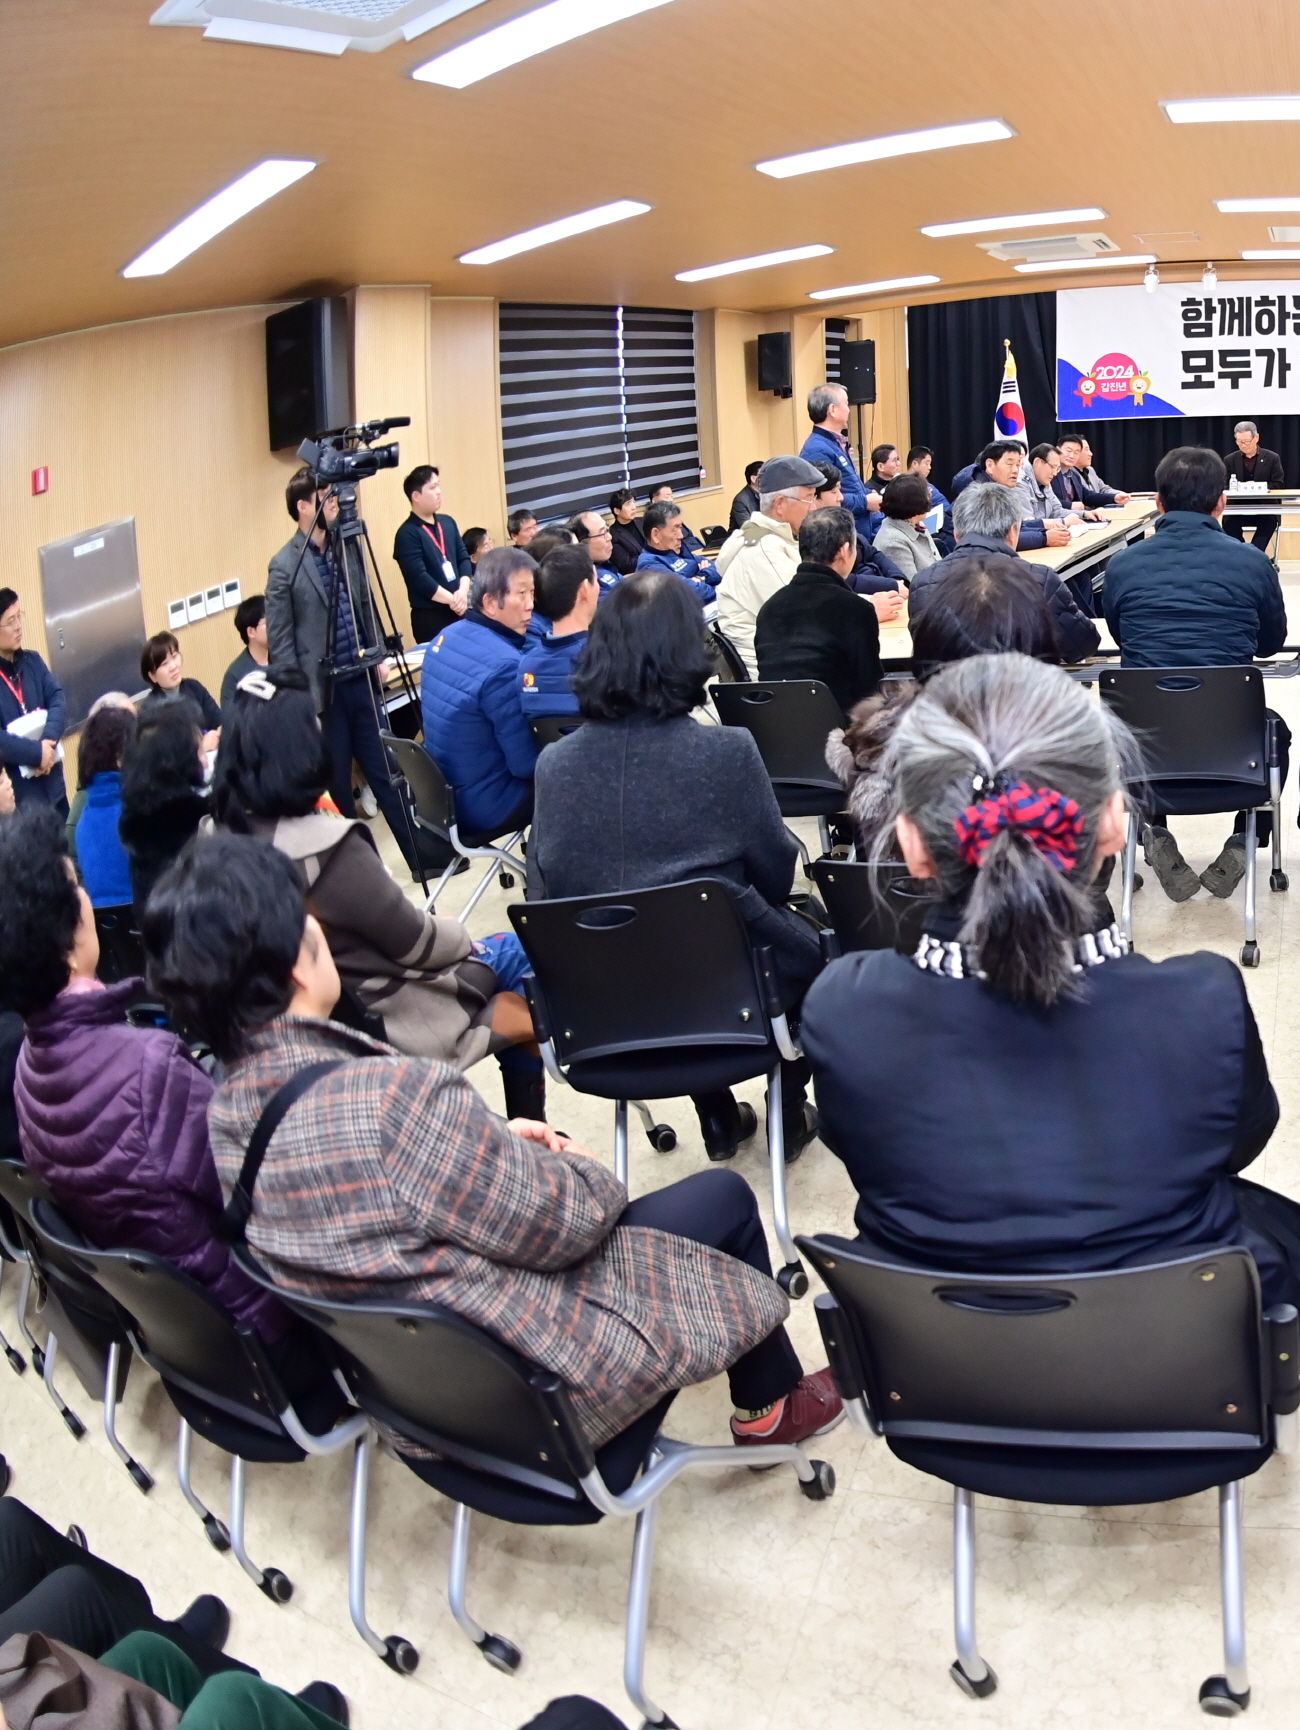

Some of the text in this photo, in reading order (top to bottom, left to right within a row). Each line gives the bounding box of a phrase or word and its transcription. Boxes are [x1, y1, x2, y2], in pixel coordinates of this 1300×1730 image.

[1095, 364, 1135, 380] 2024
[1180, 347, 1292, 390] 모두가
[1101, 381, 1127, 393] 갑진년
